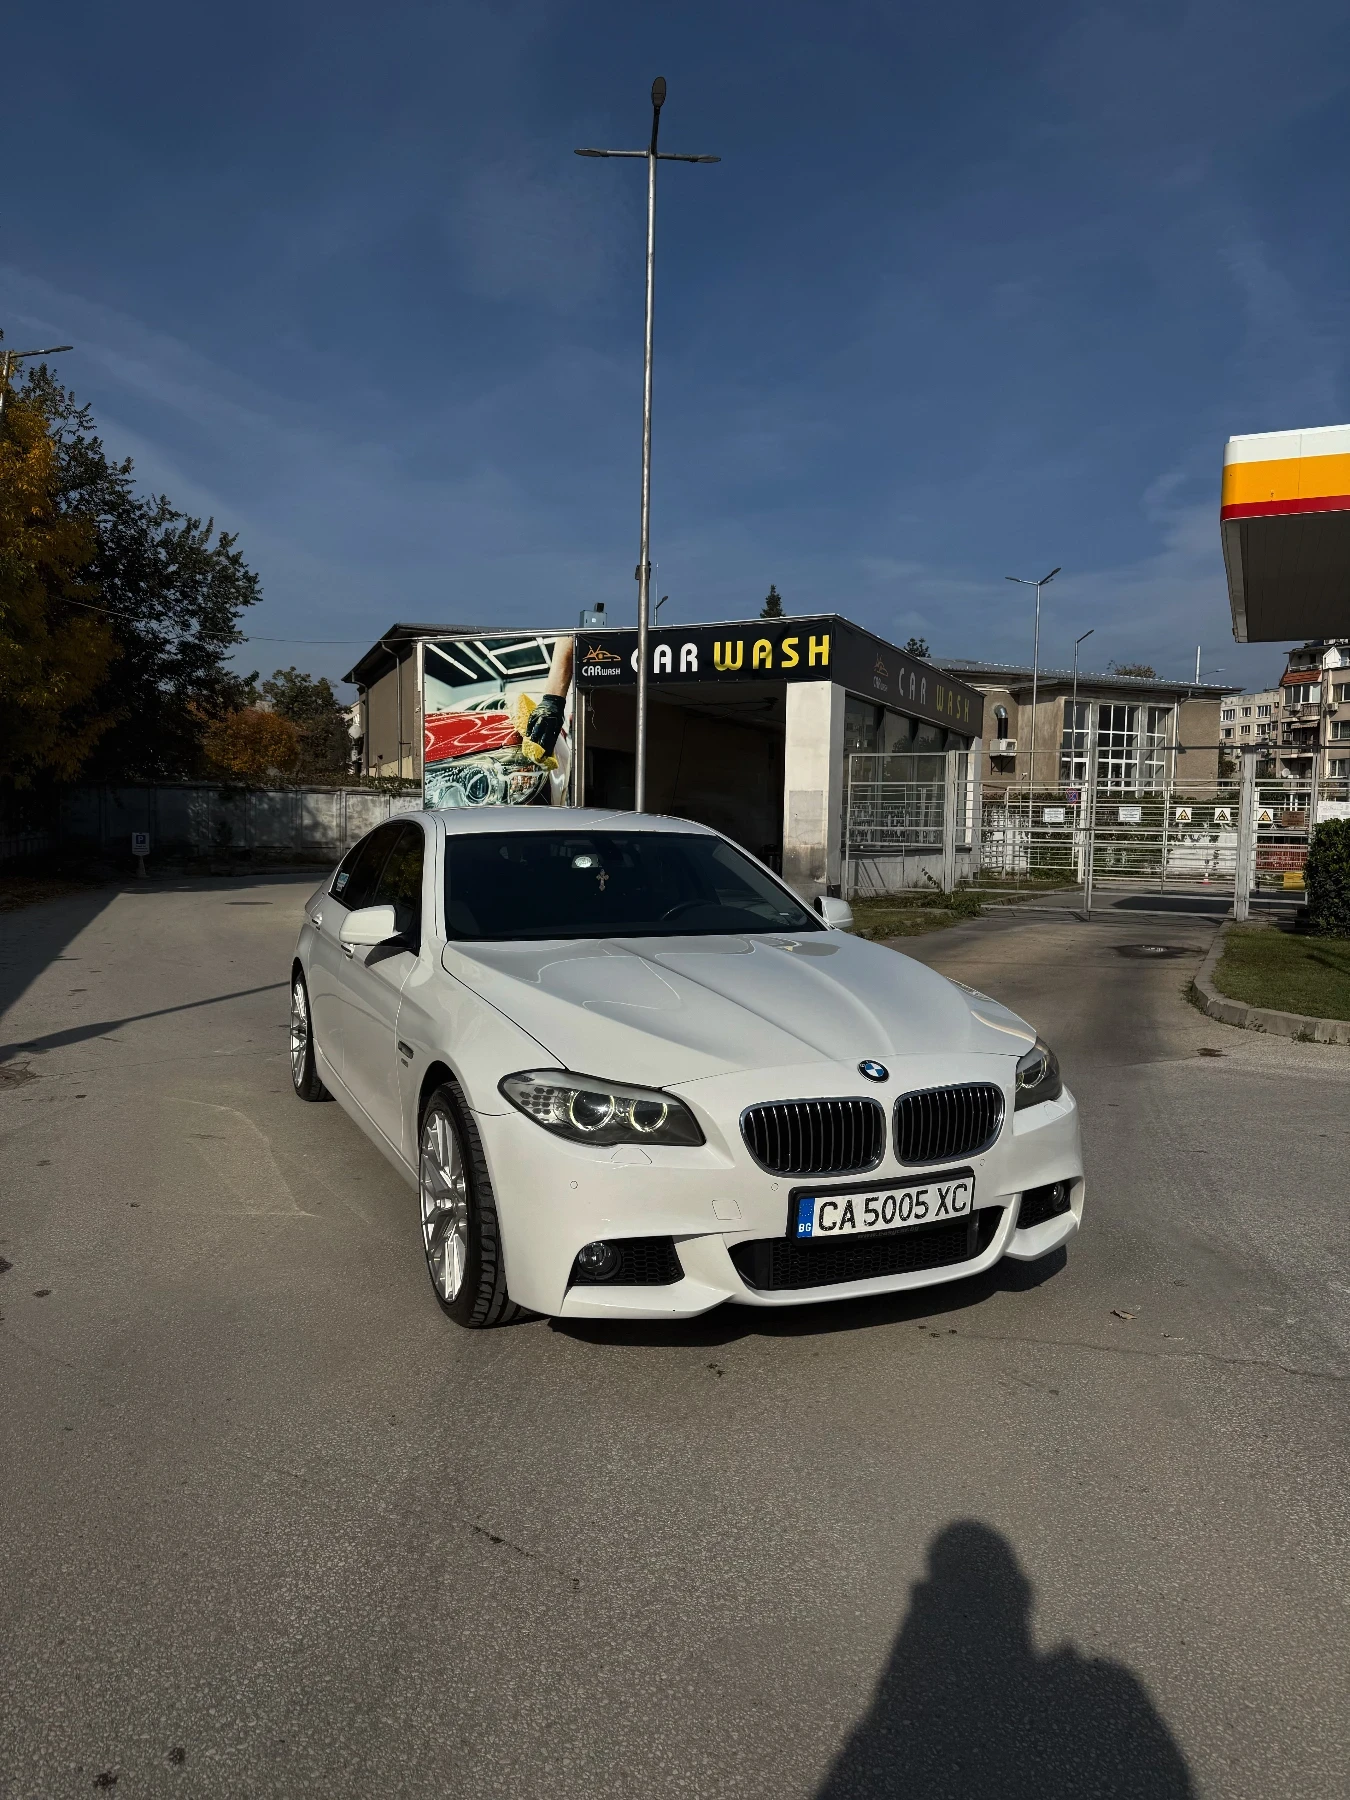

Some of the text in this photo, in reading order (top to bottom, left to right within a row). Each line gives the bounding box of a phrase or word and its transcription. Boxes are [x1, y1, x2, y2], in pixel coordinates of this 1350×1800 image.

[581, 665, 621, 676] CARWASH
[713, 634, 830, 671] WASH
[898, 667, 927, 705] CAR
[936, 684, 970, 723] WASH
[818, 1183, 968, 1232] CA 5005 XC
[798, 1223, 812, 1233] BG
